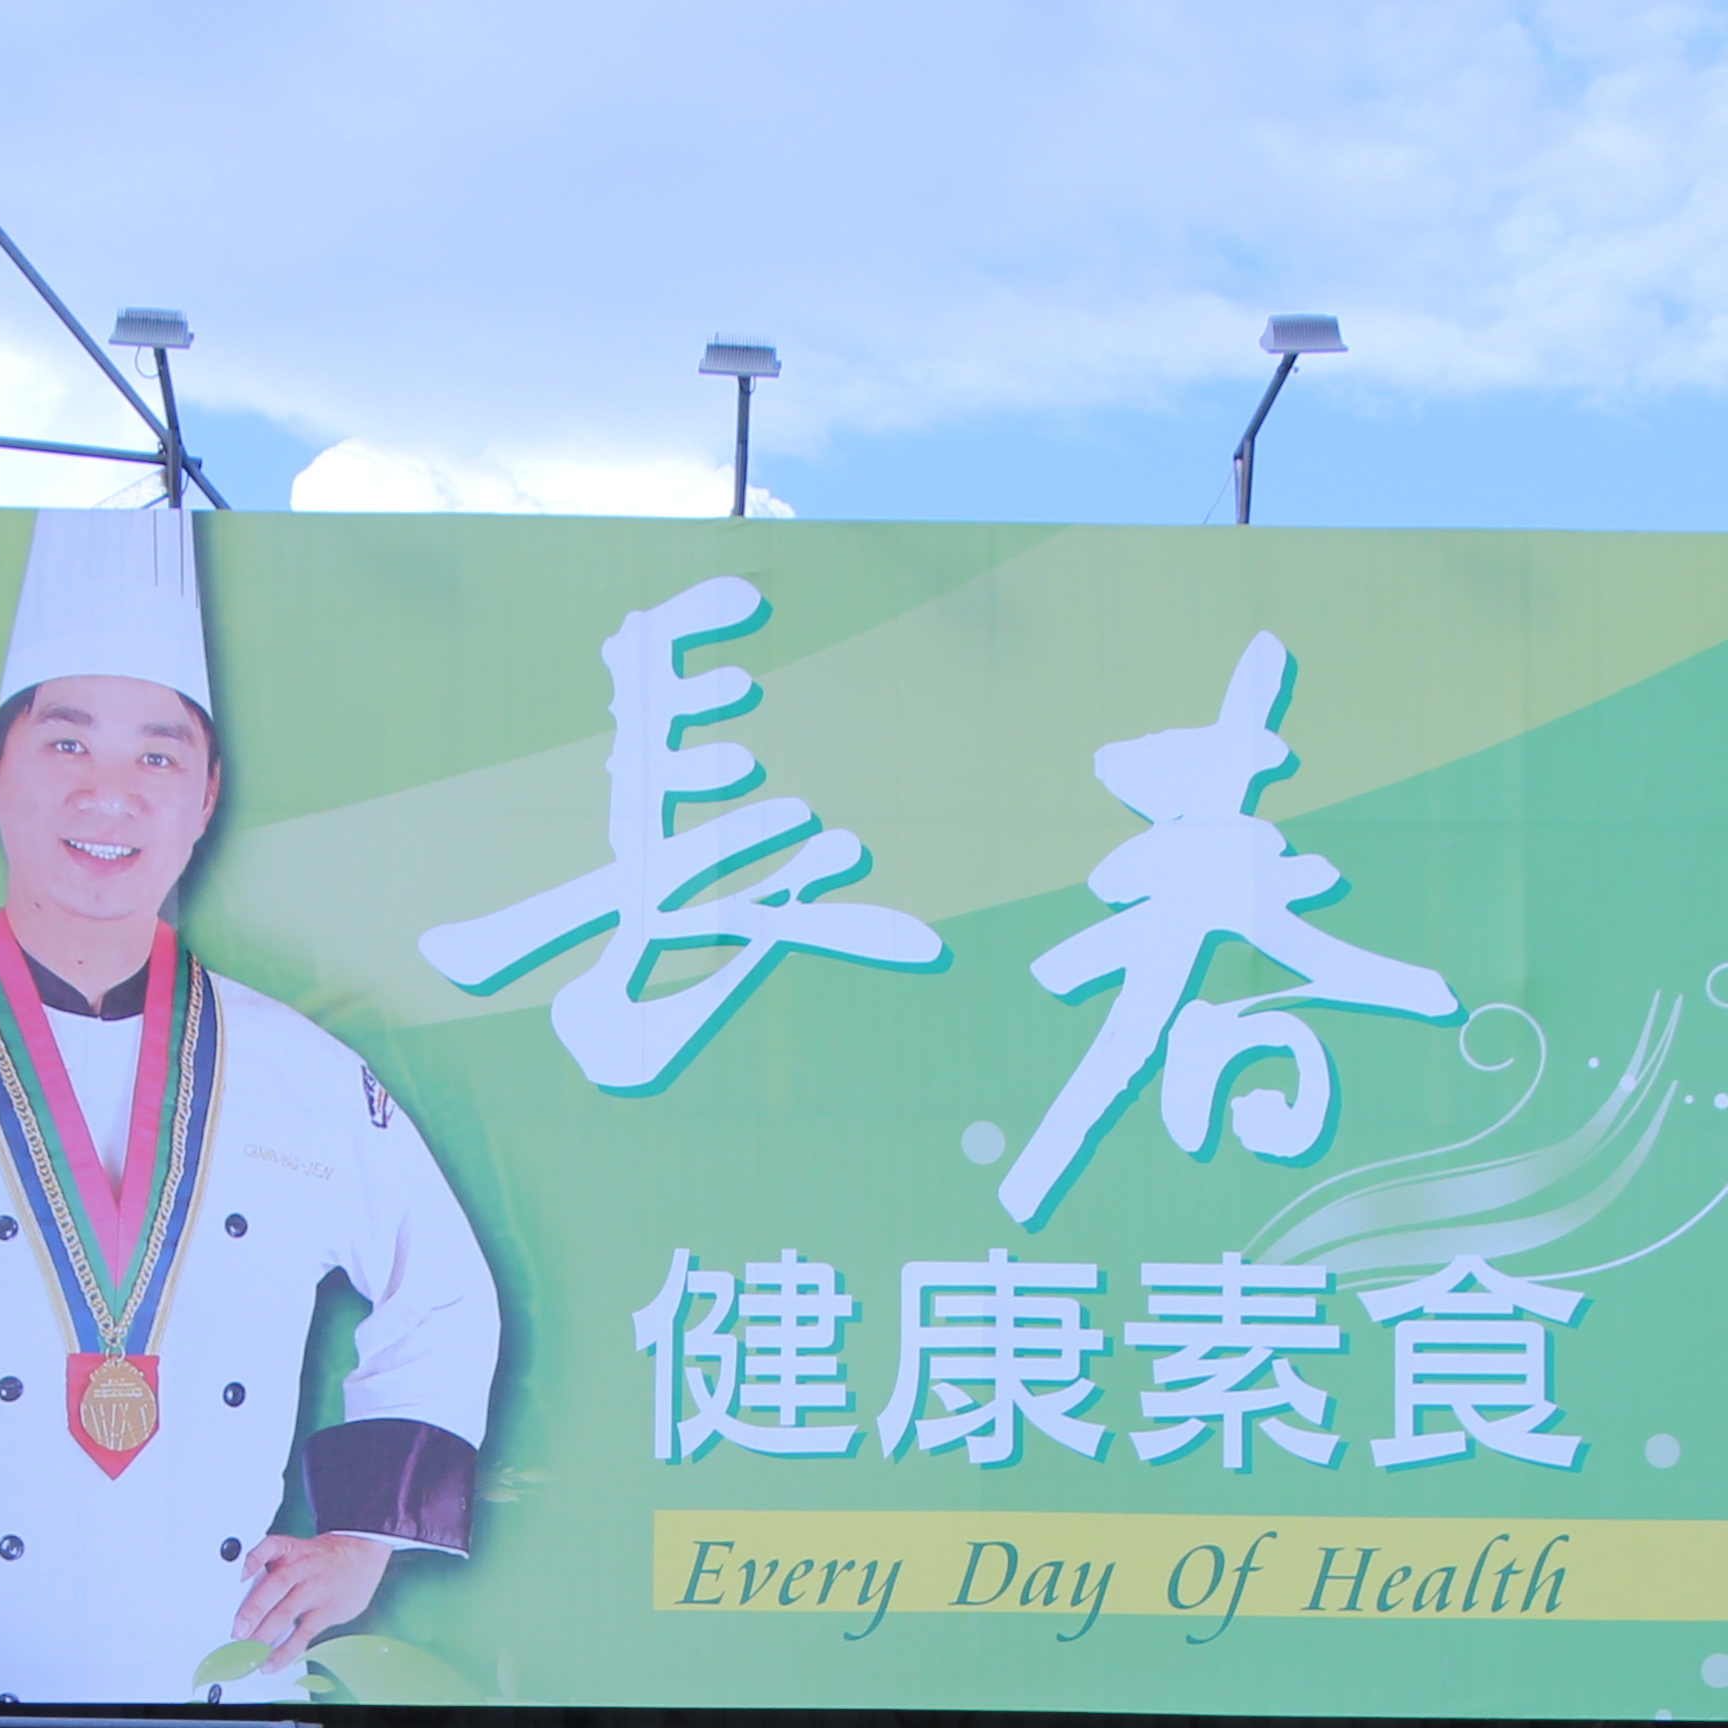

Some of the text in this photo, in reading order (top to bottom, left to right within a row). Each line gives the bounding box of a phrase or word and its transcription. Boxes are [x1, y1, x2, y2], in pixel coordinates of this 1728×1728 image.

[417, 575, 1462, 1228] 長春
[633, 1247, 1587, 1470] 健康素食
[675, 1531, 1571, 1643] Every Day Of Health
